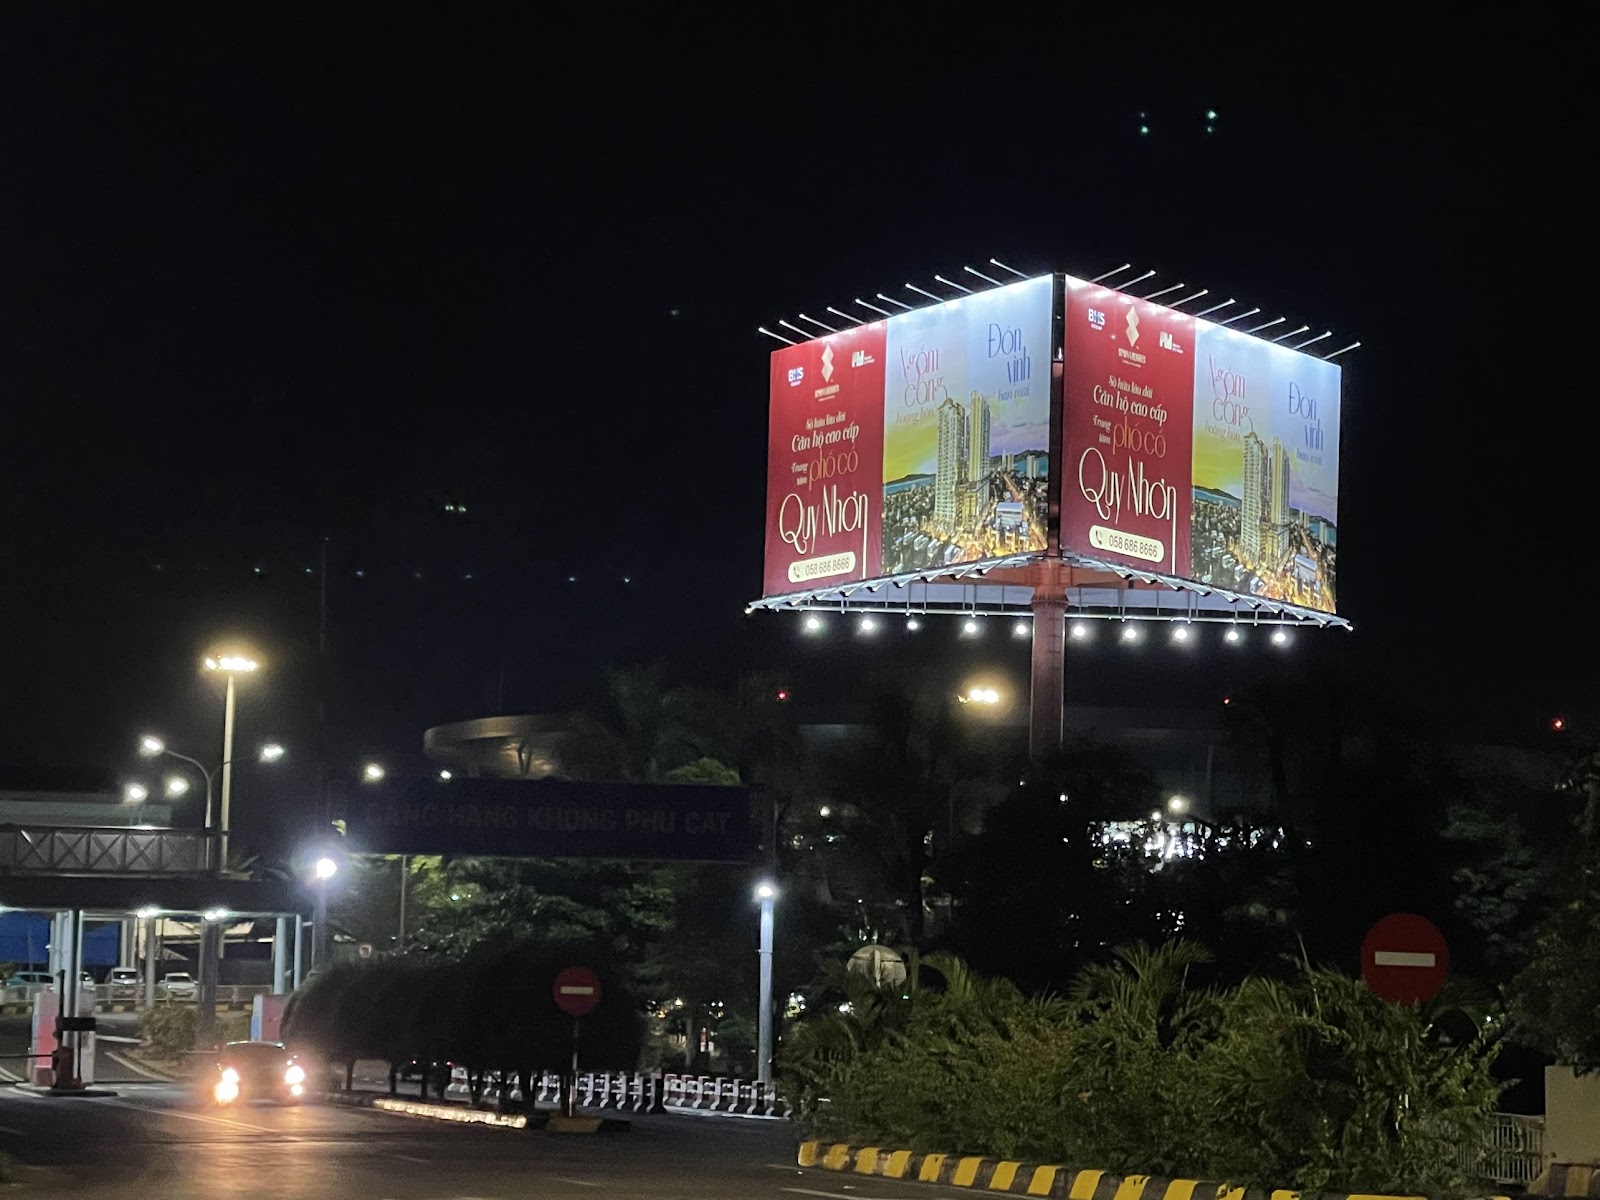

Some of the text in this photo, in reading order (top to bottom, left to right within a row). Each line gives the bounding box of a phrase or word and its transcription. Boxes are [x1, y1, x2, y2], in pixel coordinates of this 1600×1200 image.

[1115, 390, 1129, 415] hộ
[1130, 401, 1148, 417] cao
[1149, 404, 1168, 427] cấp
[812, 430, 824, 449] hộ
[825, 429, 841, 444] cao
[842, 420, 859, 443] cấp
[1079, 447, 1177, 576] Quy Nhơn
[779, 484, 869, 580] Quy Nhơn
[1109, 534, 1158, 558] 058 686 8666
[805, 557, 850, 576] 058 686 8666
